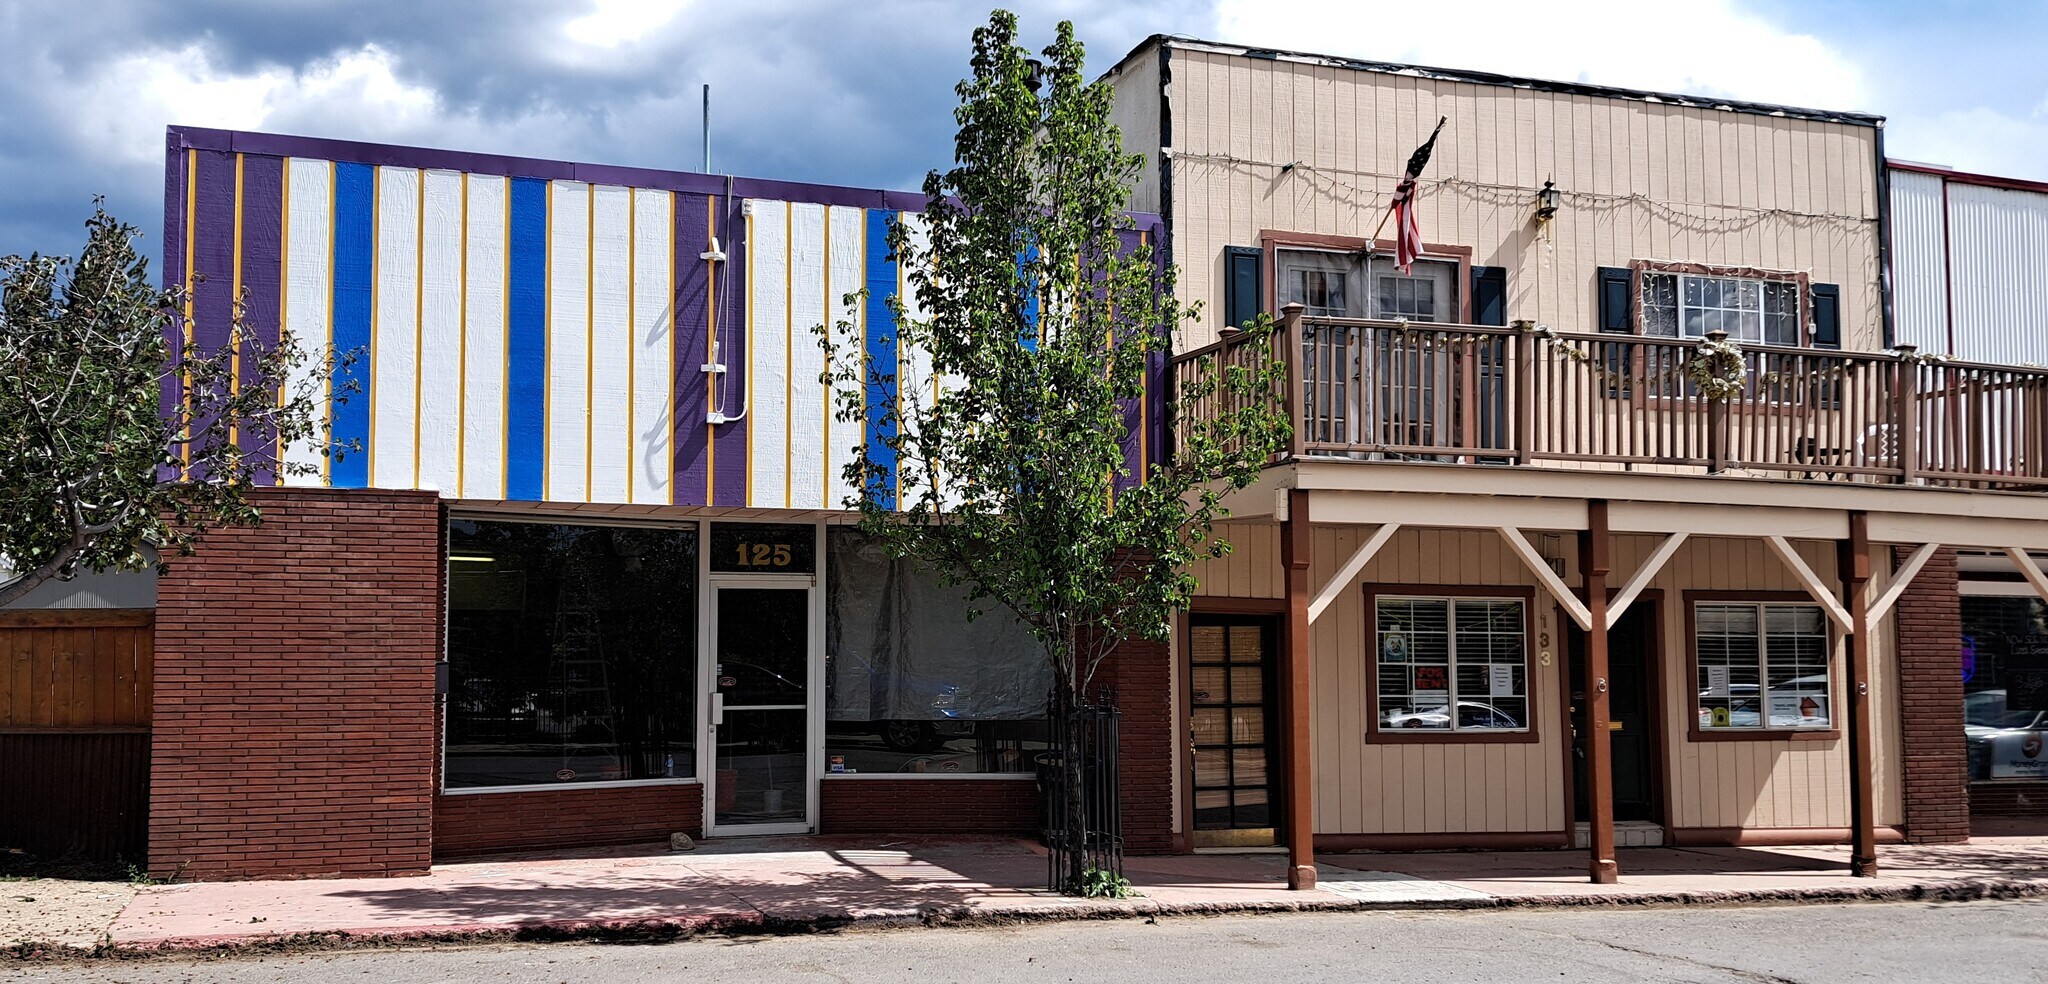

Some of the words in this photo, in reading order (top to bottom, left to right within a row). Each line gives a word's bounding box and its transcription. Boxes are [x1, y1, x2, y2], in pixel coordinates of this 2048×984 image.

[736, 543, 791, 566] 125
[1540, 615, 1551, 666] 133
[1416, 667, 1444, 677] FOR
